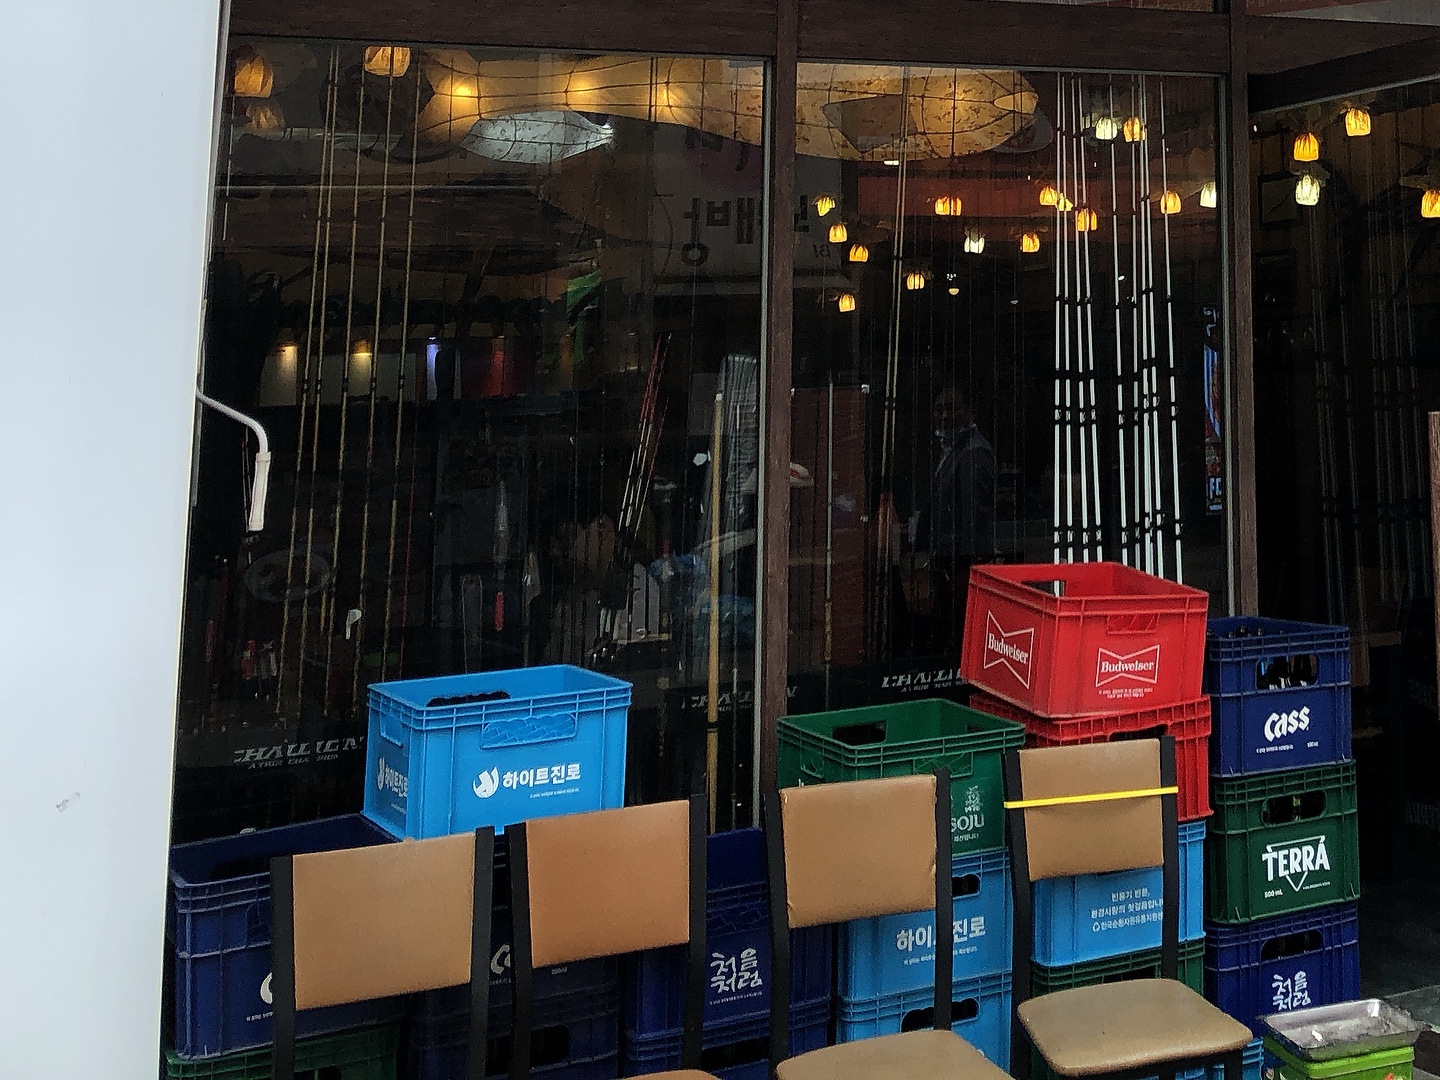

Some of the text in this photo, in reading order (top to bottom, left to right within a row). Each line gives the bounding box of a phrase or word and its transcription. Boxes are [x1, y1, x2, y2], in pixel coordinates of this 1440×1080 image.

[988, 632, 1029, 664] Budweiser
[1100, 659, 1155, 673] Budweiser
[1264, 705, 1311, 742] Cass
[502, 762, 582, 790] 하이트진로
[1261, 842, 1331, 882] TERRA
[896, 916, 986, 952] 하이진로
